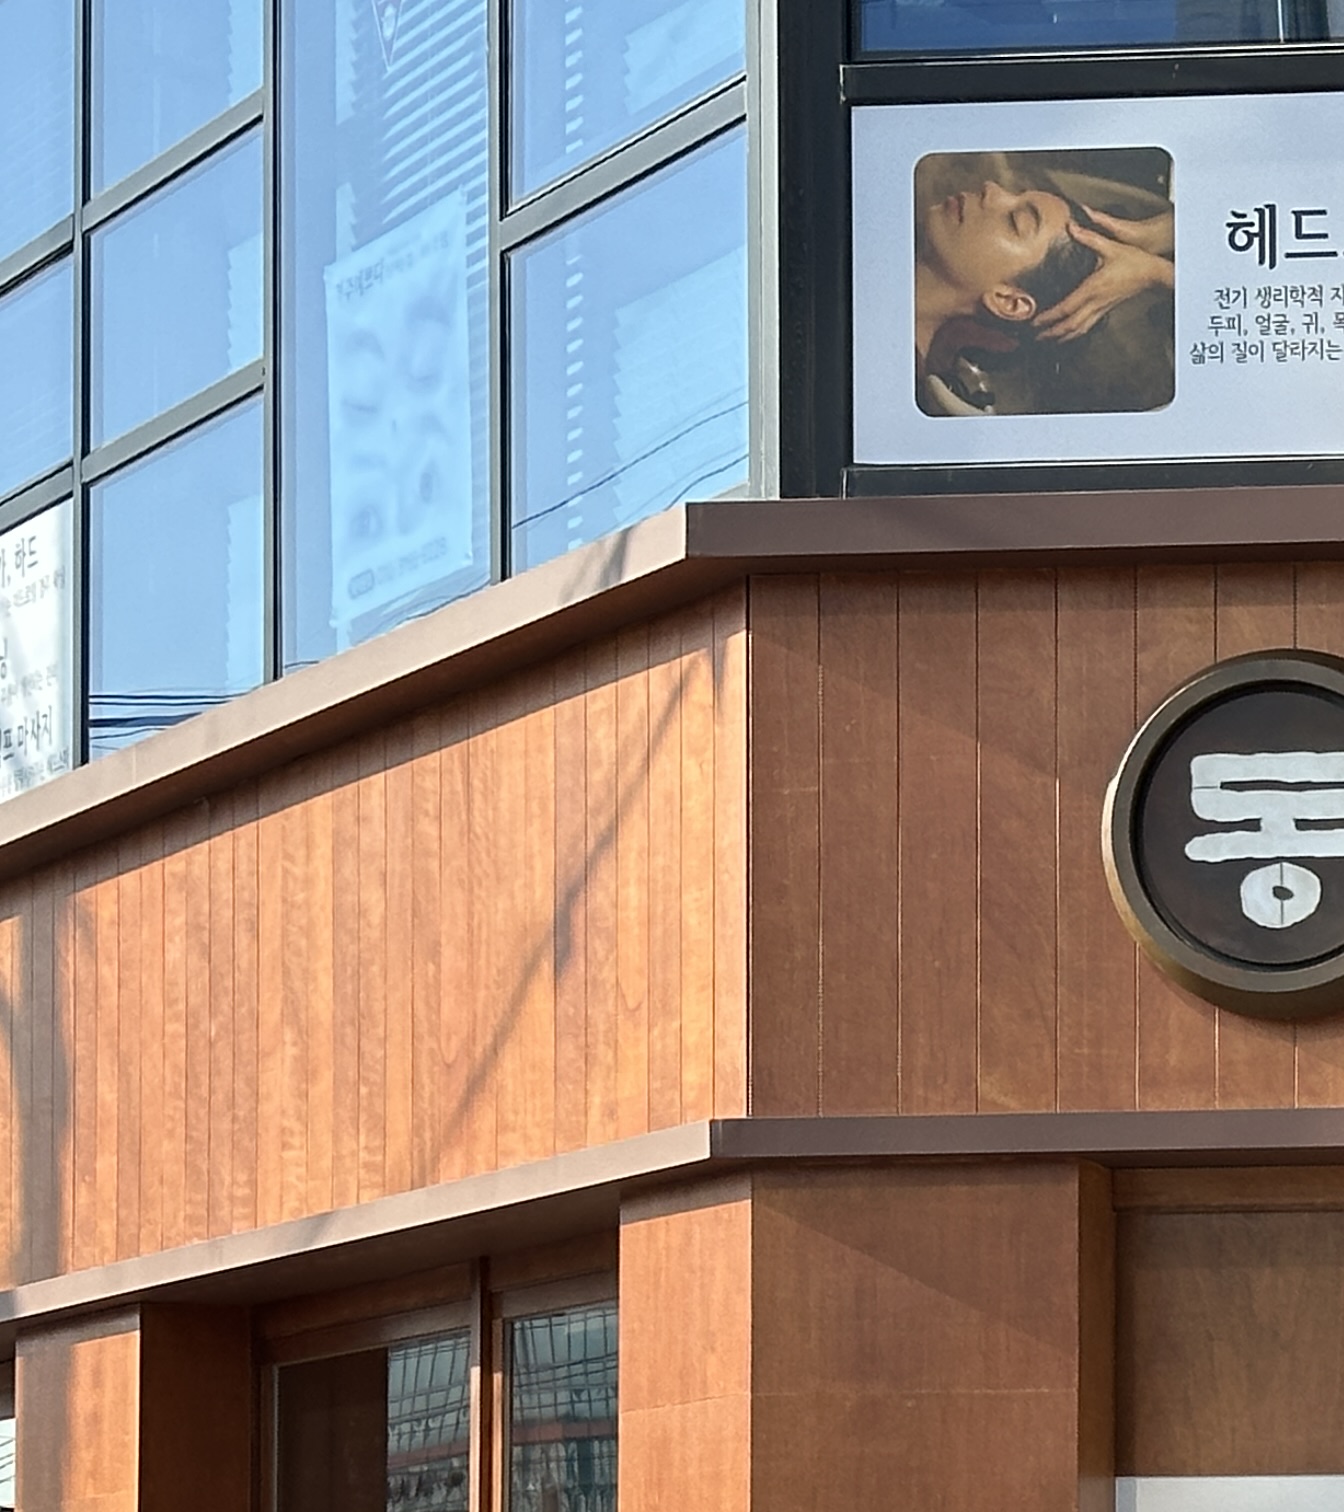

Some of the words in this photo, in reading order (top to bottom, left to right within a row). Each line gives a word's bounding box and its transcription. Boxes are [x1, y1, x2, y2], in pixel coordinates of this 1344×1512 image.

[1214, 286, 1249, 311] 전기
[1255, 283, 1325, 310] 생리학적
[1207, 312, 1250, 338] 두피,
[1254, 309, 1296, 336] 얼굴,
[1301, 309, 1325, 334] 귀,
[1189, 340, 1225, 365] 삶의
[1231, 338, 1266, 364] 질이
[1271, 336, 1343, 364] 달라지는
